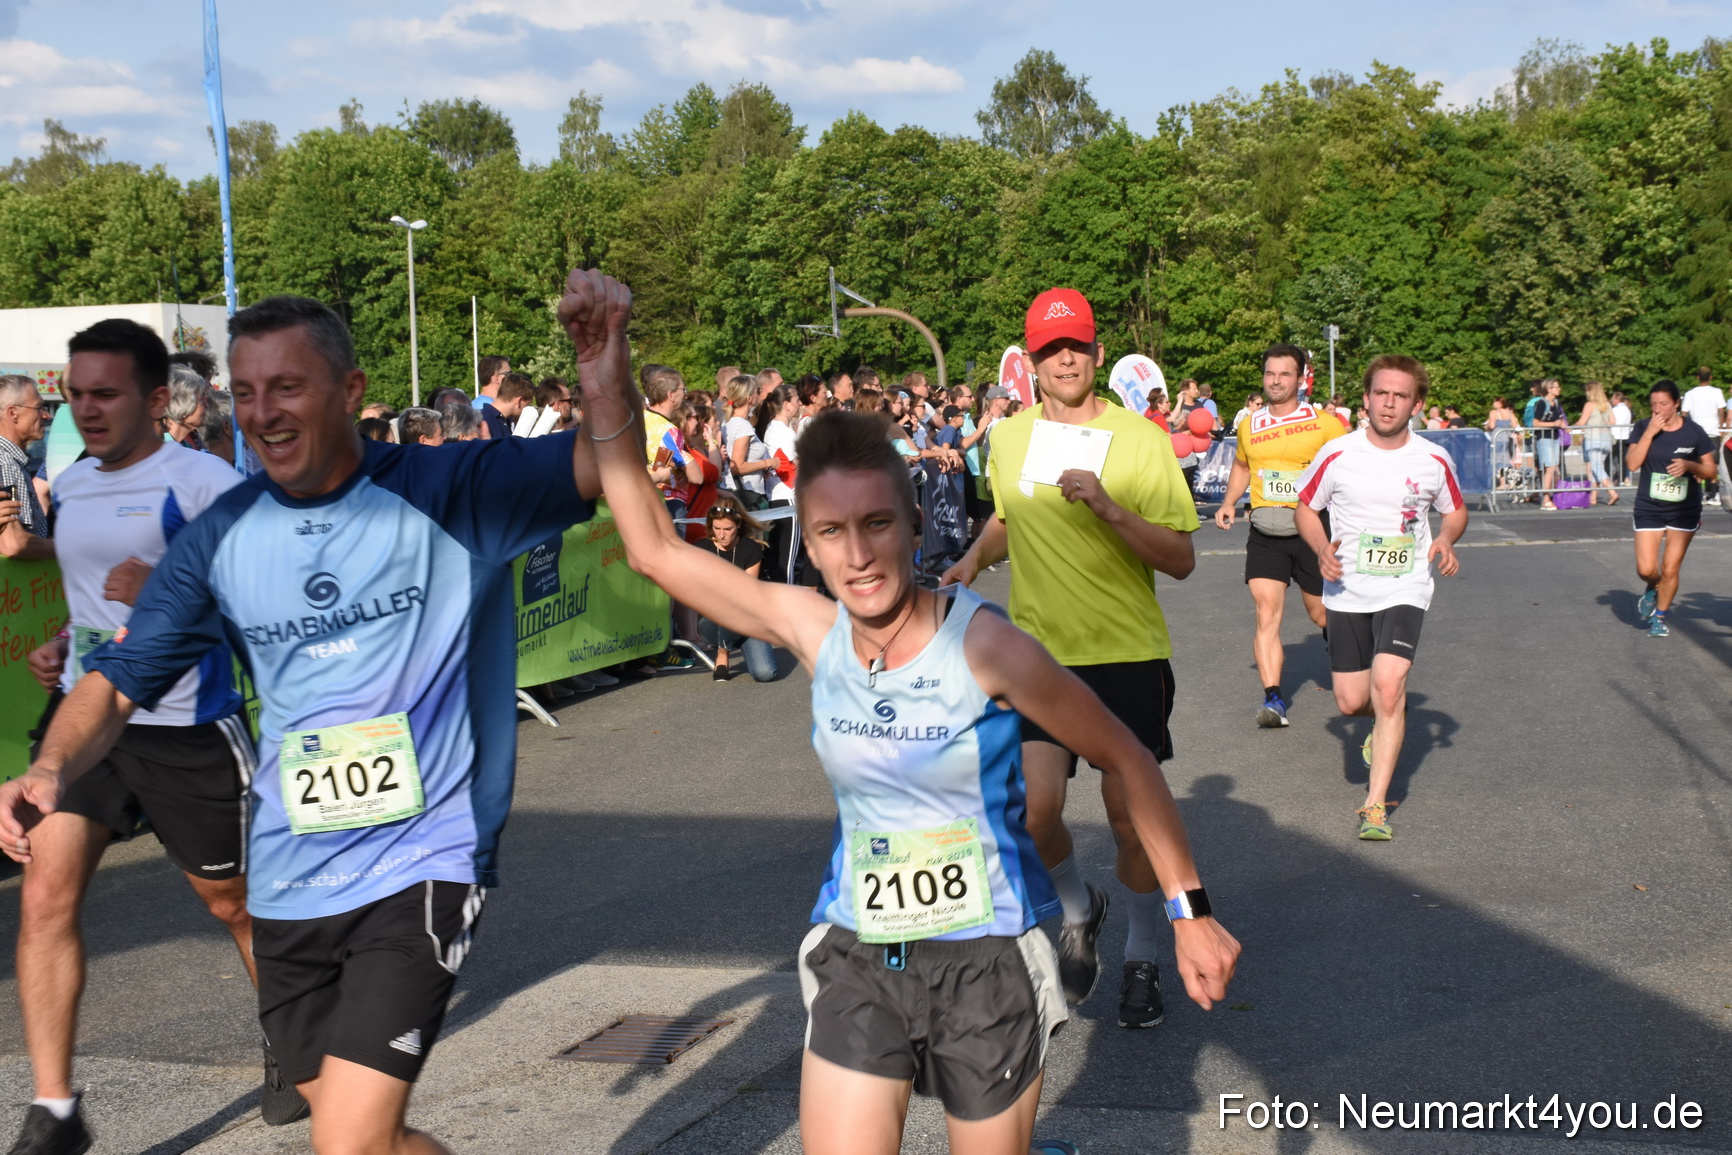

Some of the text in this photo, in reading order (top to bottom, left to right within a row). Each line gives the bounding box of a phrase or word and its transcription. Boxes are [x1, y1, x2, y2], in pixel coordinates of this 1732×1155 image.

[1250, 423, 1321, 445] MAX BÖGL
[1655, 483, 1682, 494] 1391
[531, 552, 557, 568] Fischer
[1365, 549, 1408, 565] 1786
[244, 586, 426, 647] SCHABMÜLLER
[515, 573, 590, 640] irmenlauf
[305, 637, 358, 660] TEAM
[830, 717, 949, 741] SCHABMÜLLER
[296, 756, 400, 805] 2102
[864, 863, 967, 910] 2108
